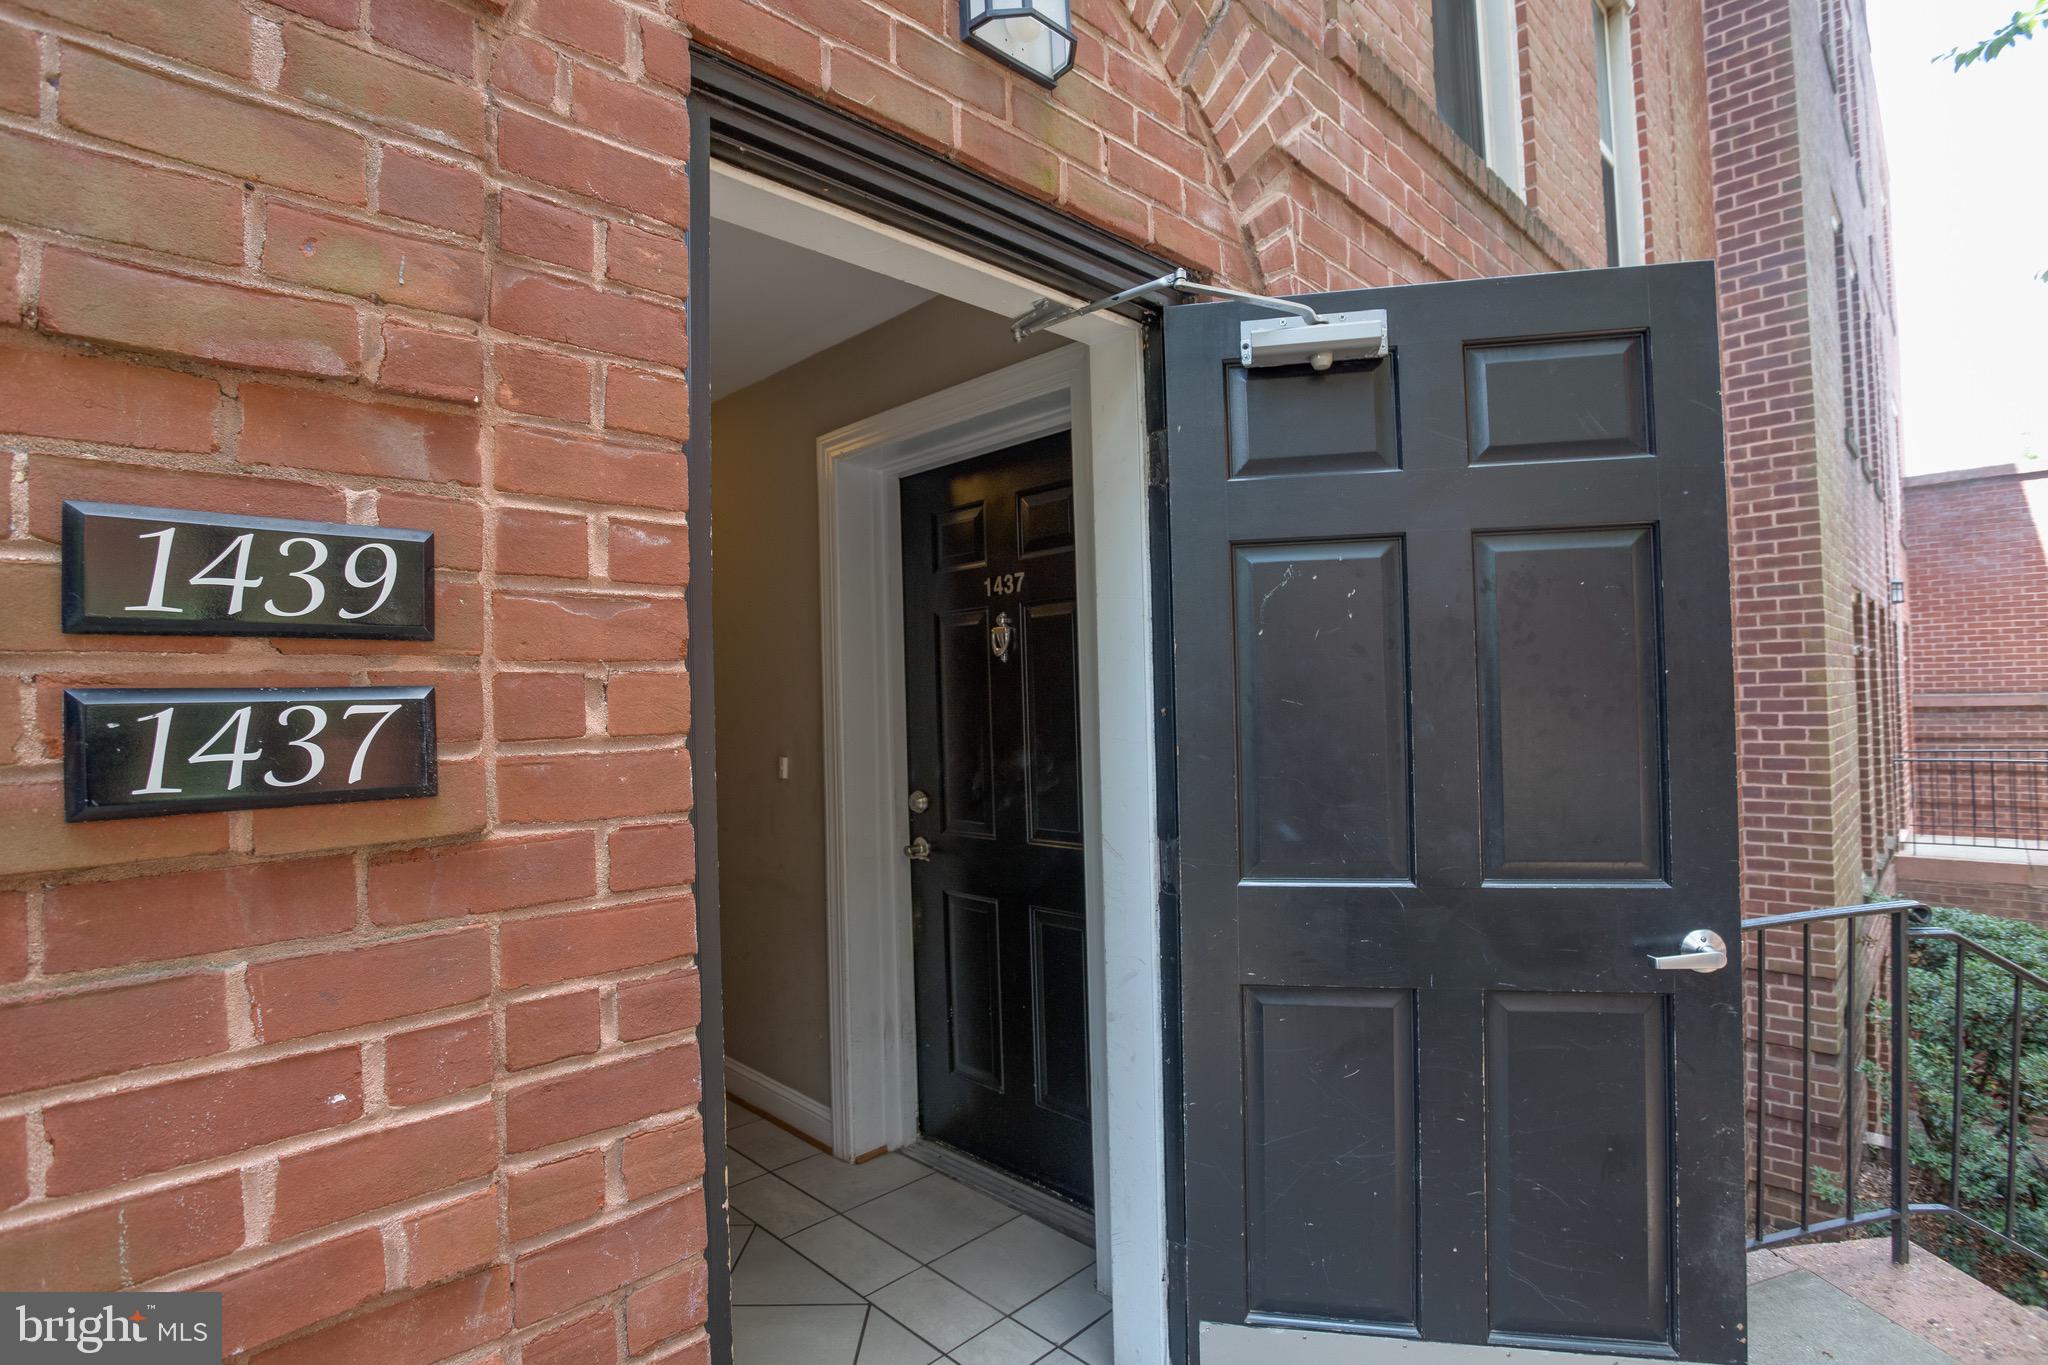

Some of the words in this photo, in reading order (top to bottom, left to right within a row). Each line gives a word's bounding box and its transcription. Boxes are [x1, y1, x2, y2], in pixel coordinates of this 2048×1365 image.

[124, 527, 398, 619] 1439
[984, 571, 1025, 597] 1437
[131, 704, 402, 795] 1437
